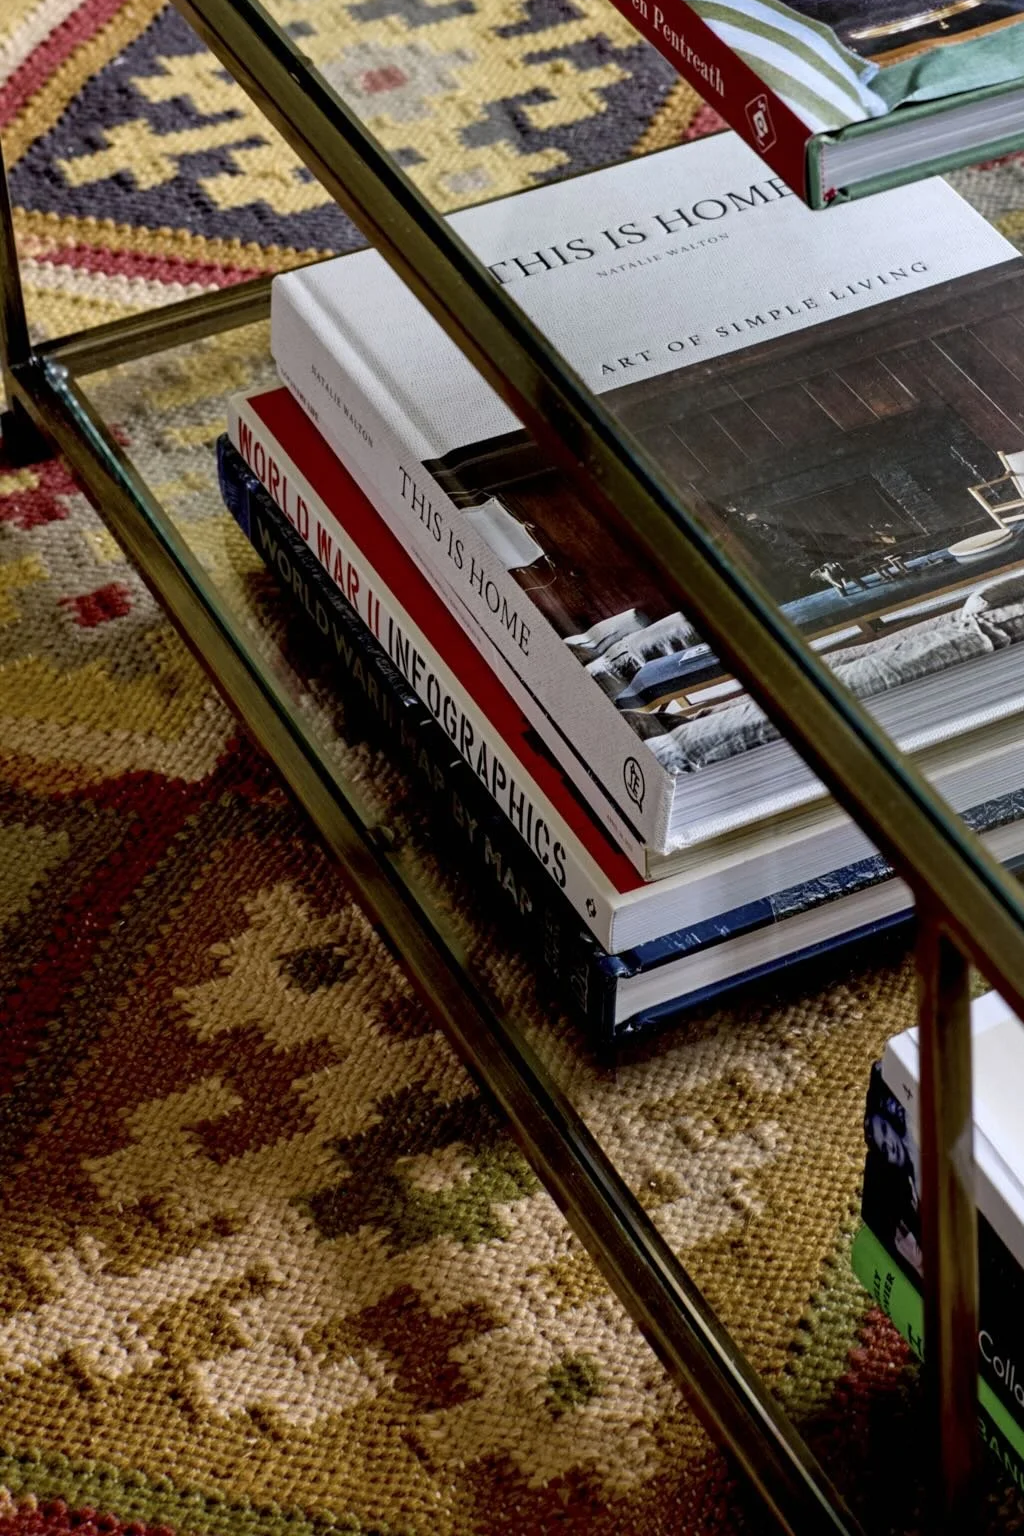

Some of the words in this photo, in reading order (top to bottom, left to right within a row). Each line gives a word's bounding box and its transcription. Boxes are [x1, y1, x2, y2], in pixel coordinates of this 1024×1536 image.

[653, 4, 725, 97] Pentreath
[488, 237, 596, 286] THIS
[600, 221, 649, 252] IS
[652, 177, 797, 236] HOME
[595, 253, 661, 280] NATALIE
[665, 231, 730, 257] WALTON
[600, 348, 651, 376] ART
[666, 334, 703, 354] OF
[714, 297, 820, 339] SIMPLE
[829, 260, 930, 302] LIVING
[399, 466, 443, 542] THIS
[447, 528, 465, 569] IS
[469, 557, 532, 657] HOME
[238, 416, 310, 542] WORLD
[316, 519, 360, 612] WAR
[367, 590, 381, 638] II
[387, 614, 568, 890] INFOGRAPHICS
[256, 515, 330, 638] WORLD
[333, 635, 379, 705] WAR
[450, 792, 478, 845] BY
[482, 832, 535, 916] MAP
